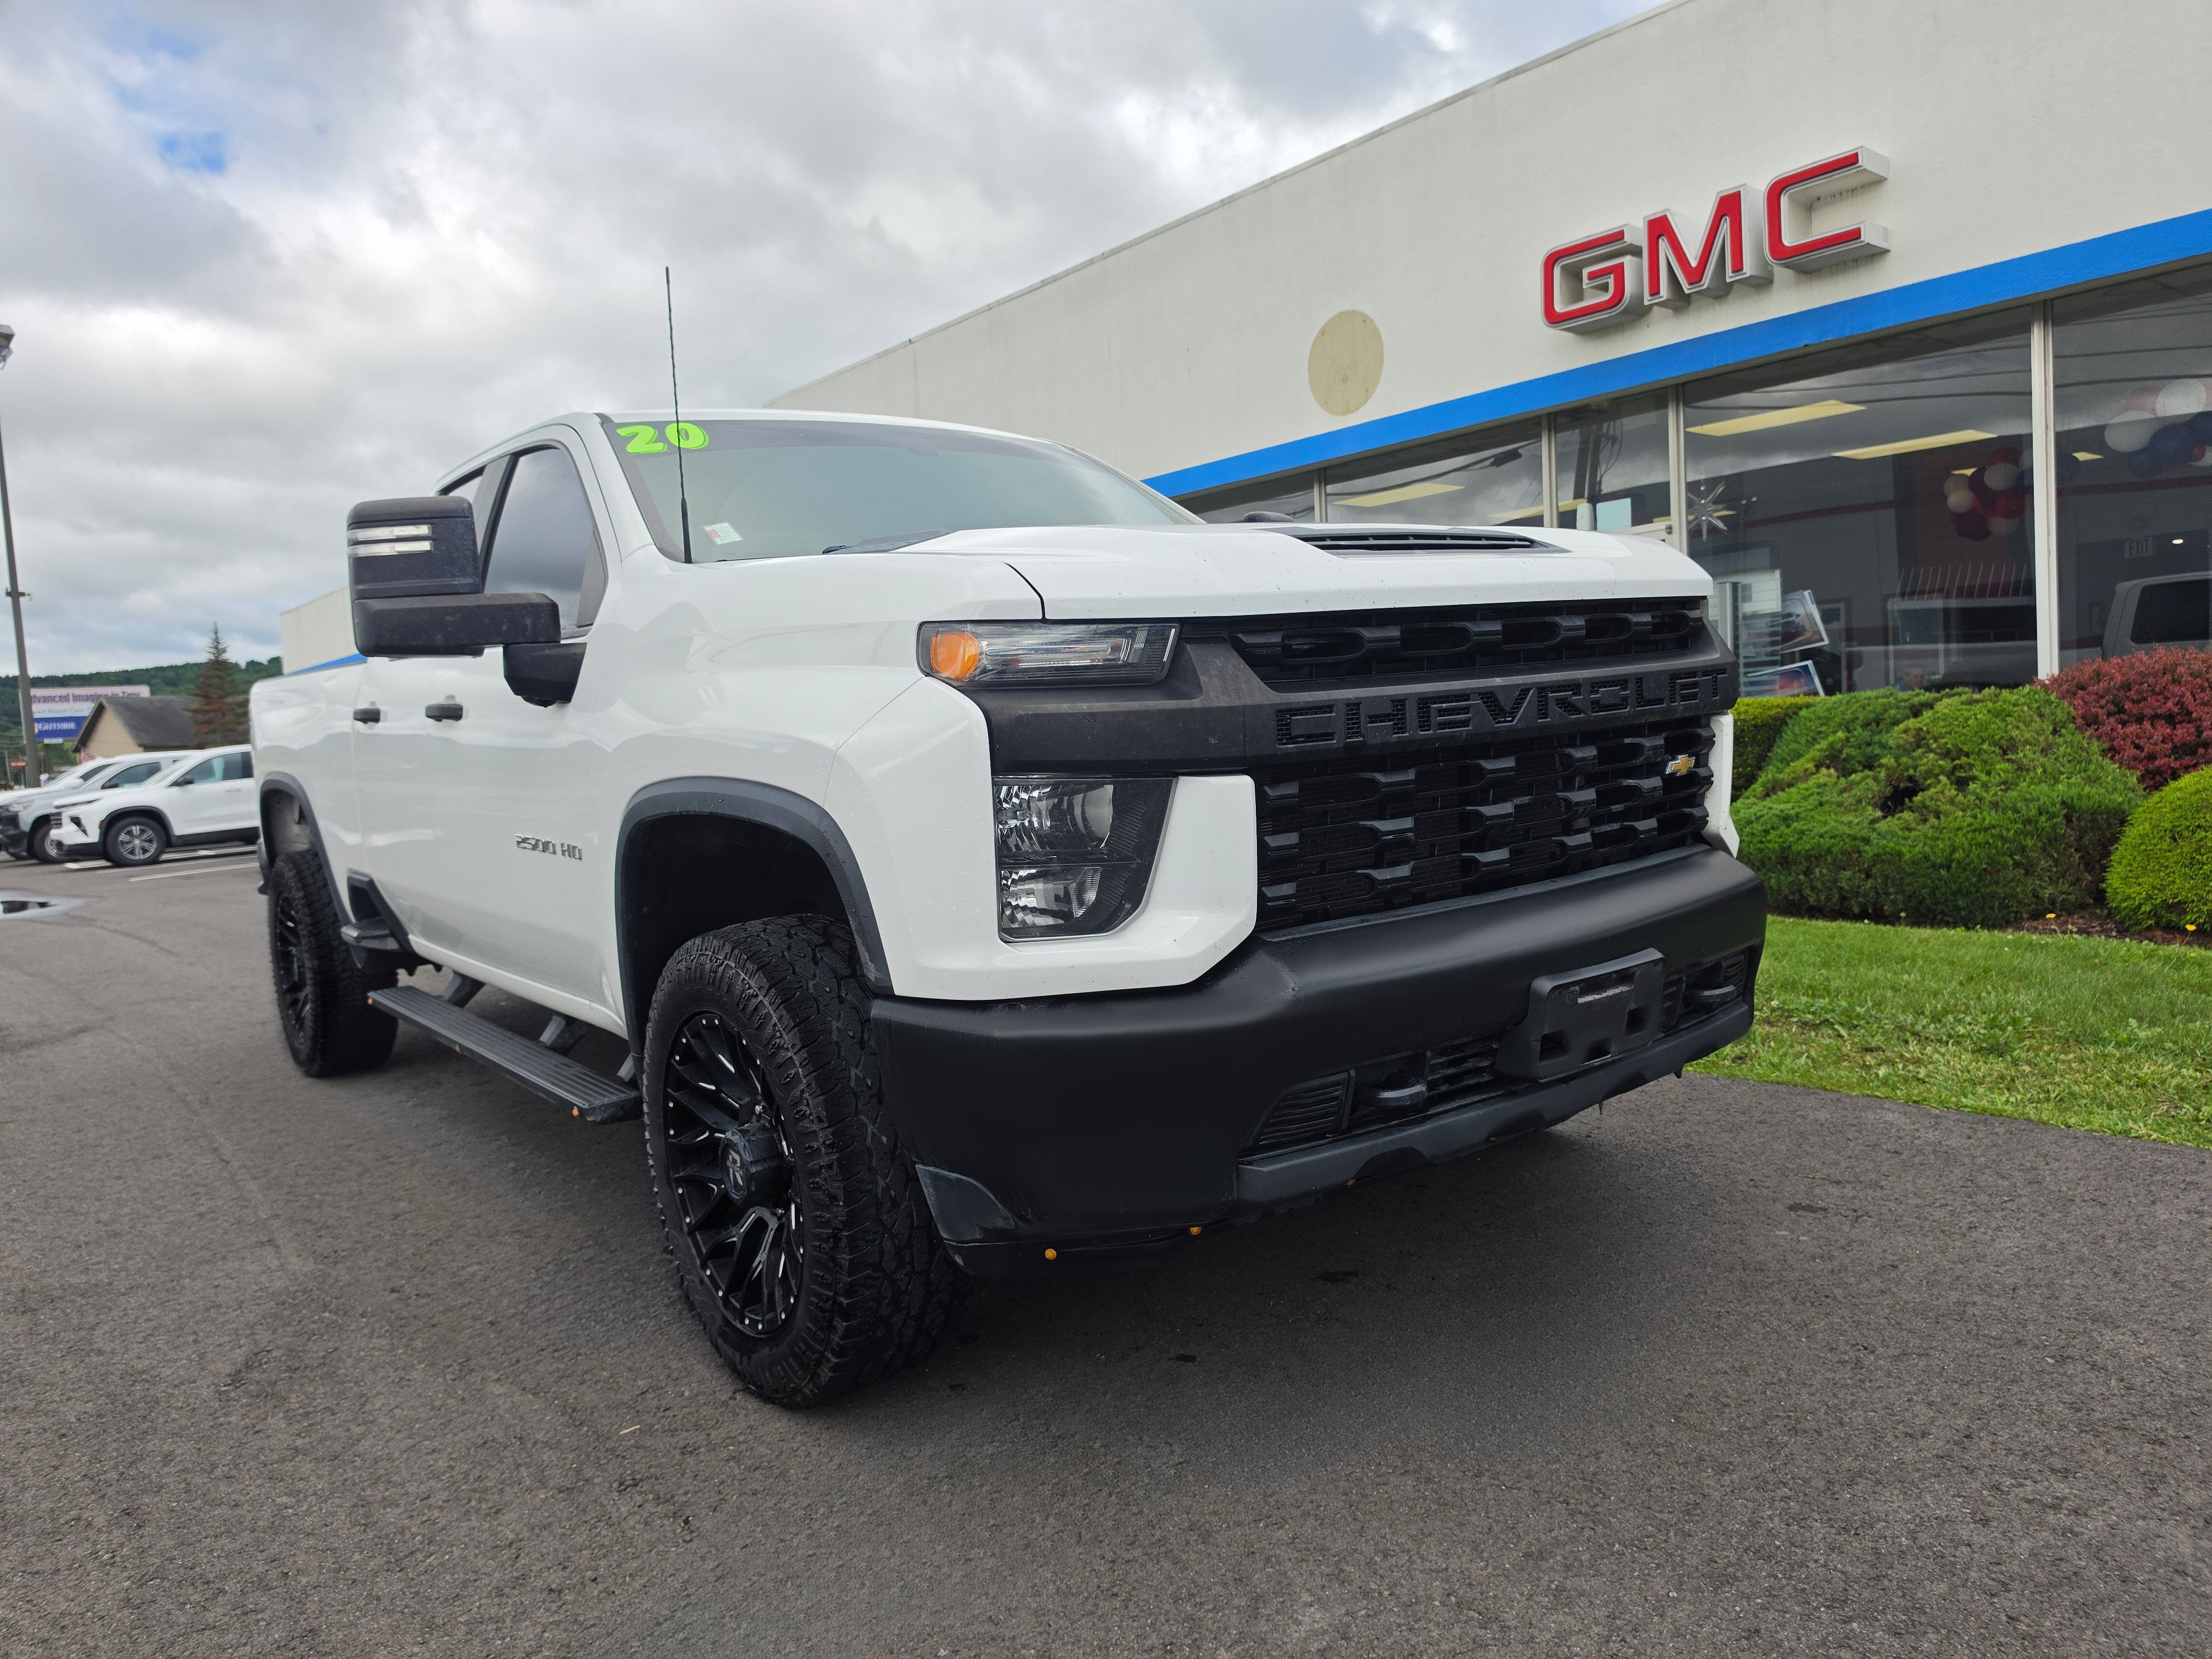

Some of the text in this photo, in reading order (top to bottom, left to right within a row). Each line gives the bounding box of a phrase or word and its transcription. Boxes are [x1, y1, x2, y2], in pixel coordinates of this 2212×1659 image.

[1541, 146, 1867, 331] GMC
[616, 422, 709, 454] 20
[2129, 539, 2149, 556] EXIT
[33, 693, 70, 704] dvanced
[1275, 668, 1728, 747] CHEVROLET
[515, 833, 583, 860] 2500 HD
